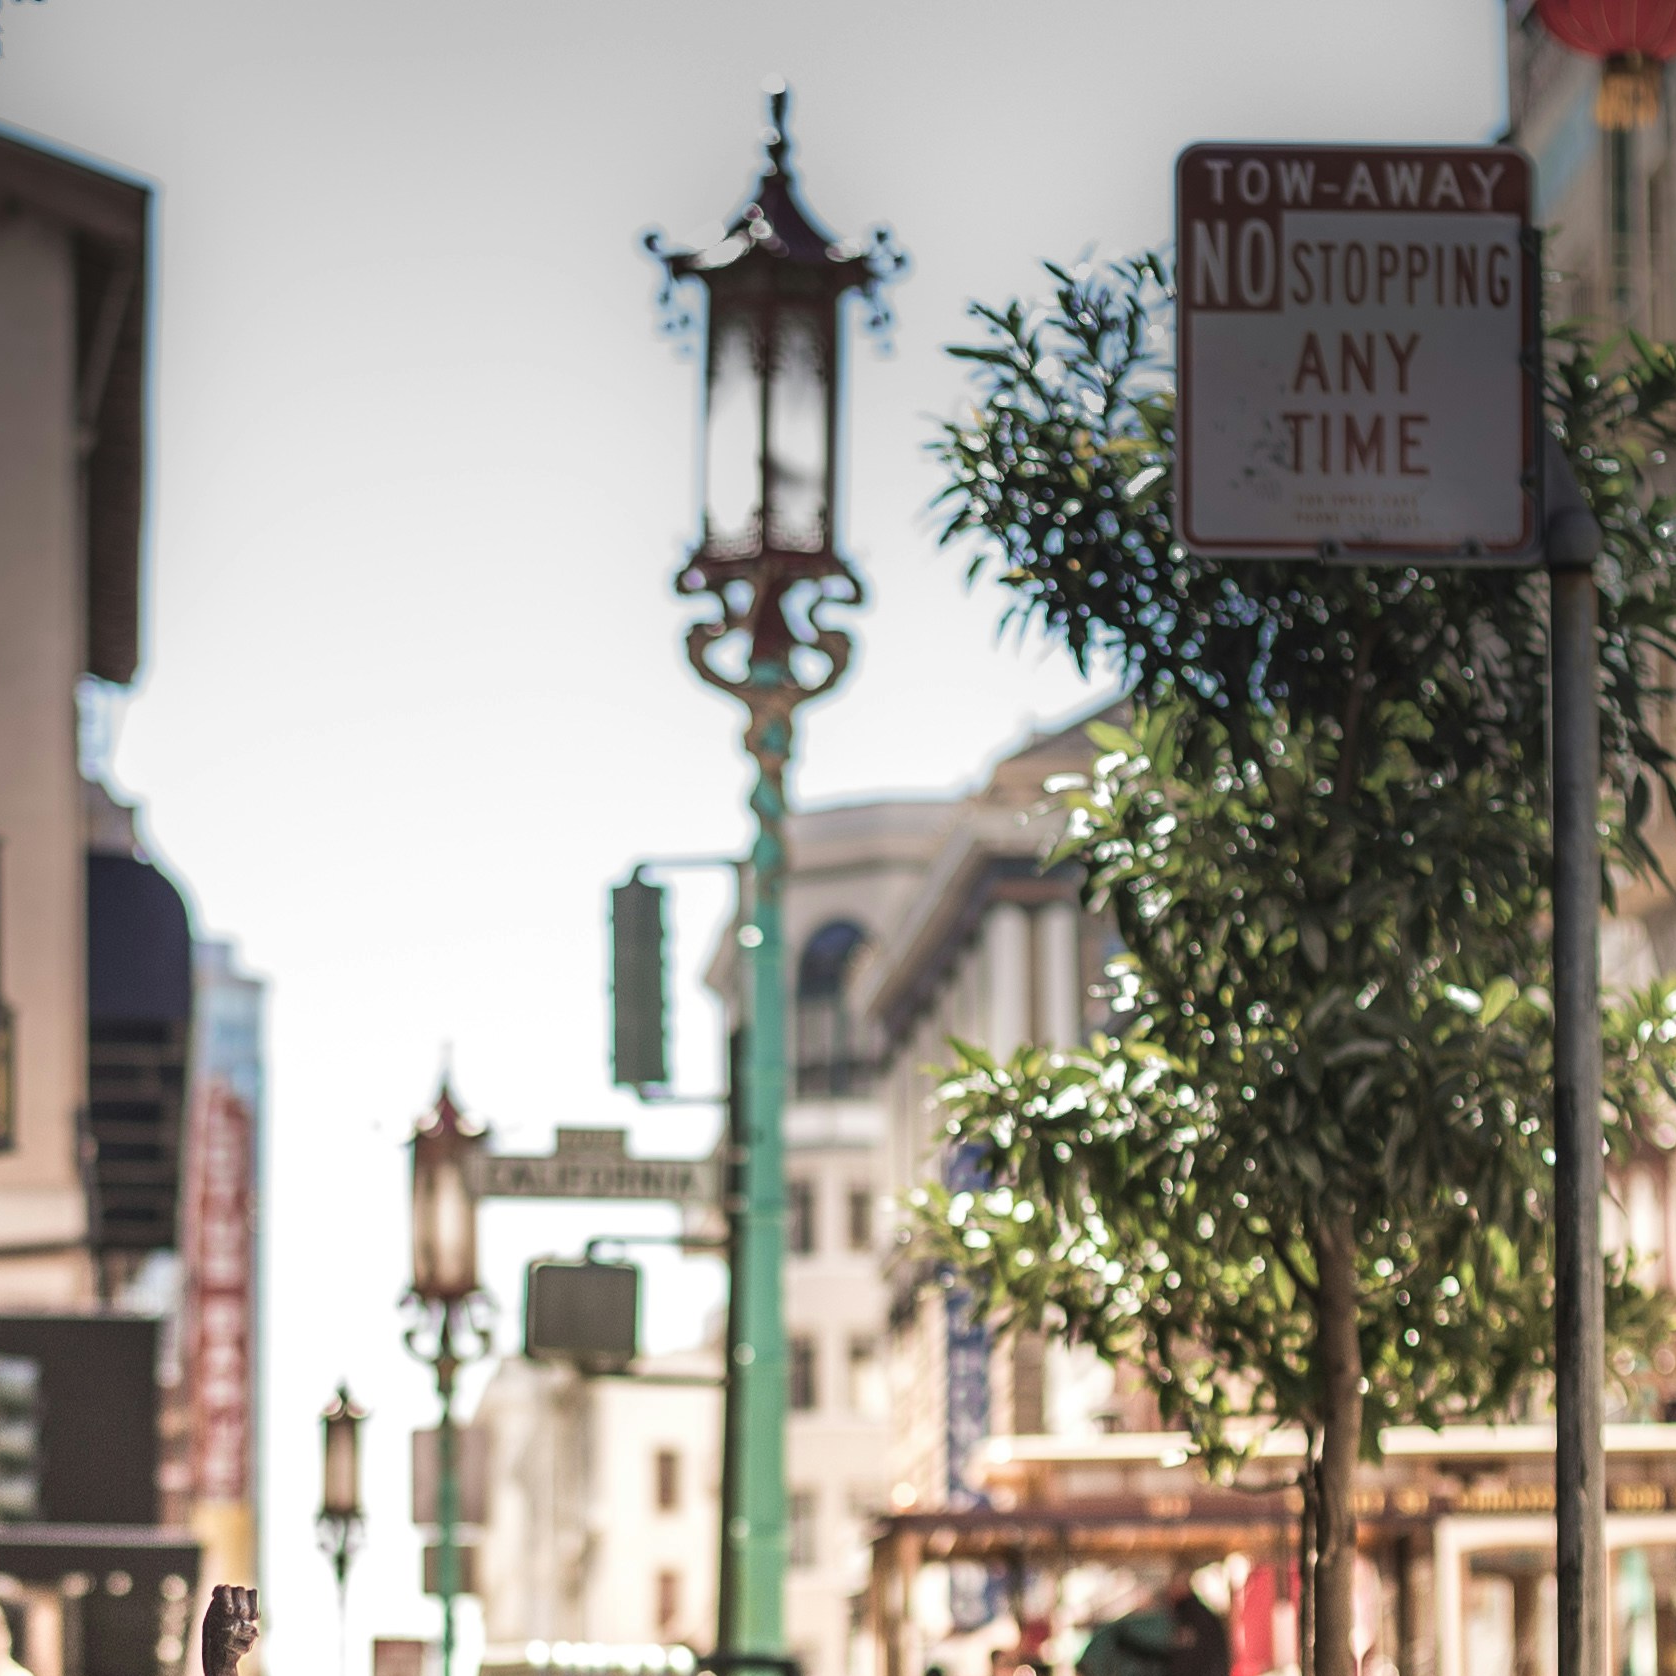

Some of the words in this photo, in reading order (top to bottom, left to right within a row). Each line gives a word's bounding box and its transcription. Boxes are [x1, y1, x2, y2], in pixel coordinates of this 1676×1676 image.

[1206, 158, 1504, 208] TOW-AWAY
[1193, 219, 1277, 307] NO
[1292, 240, 1512, 309] STOPPING
[1293, 332, 1421, 394] ANY
[1283, 413, 1431, 477] TIME
